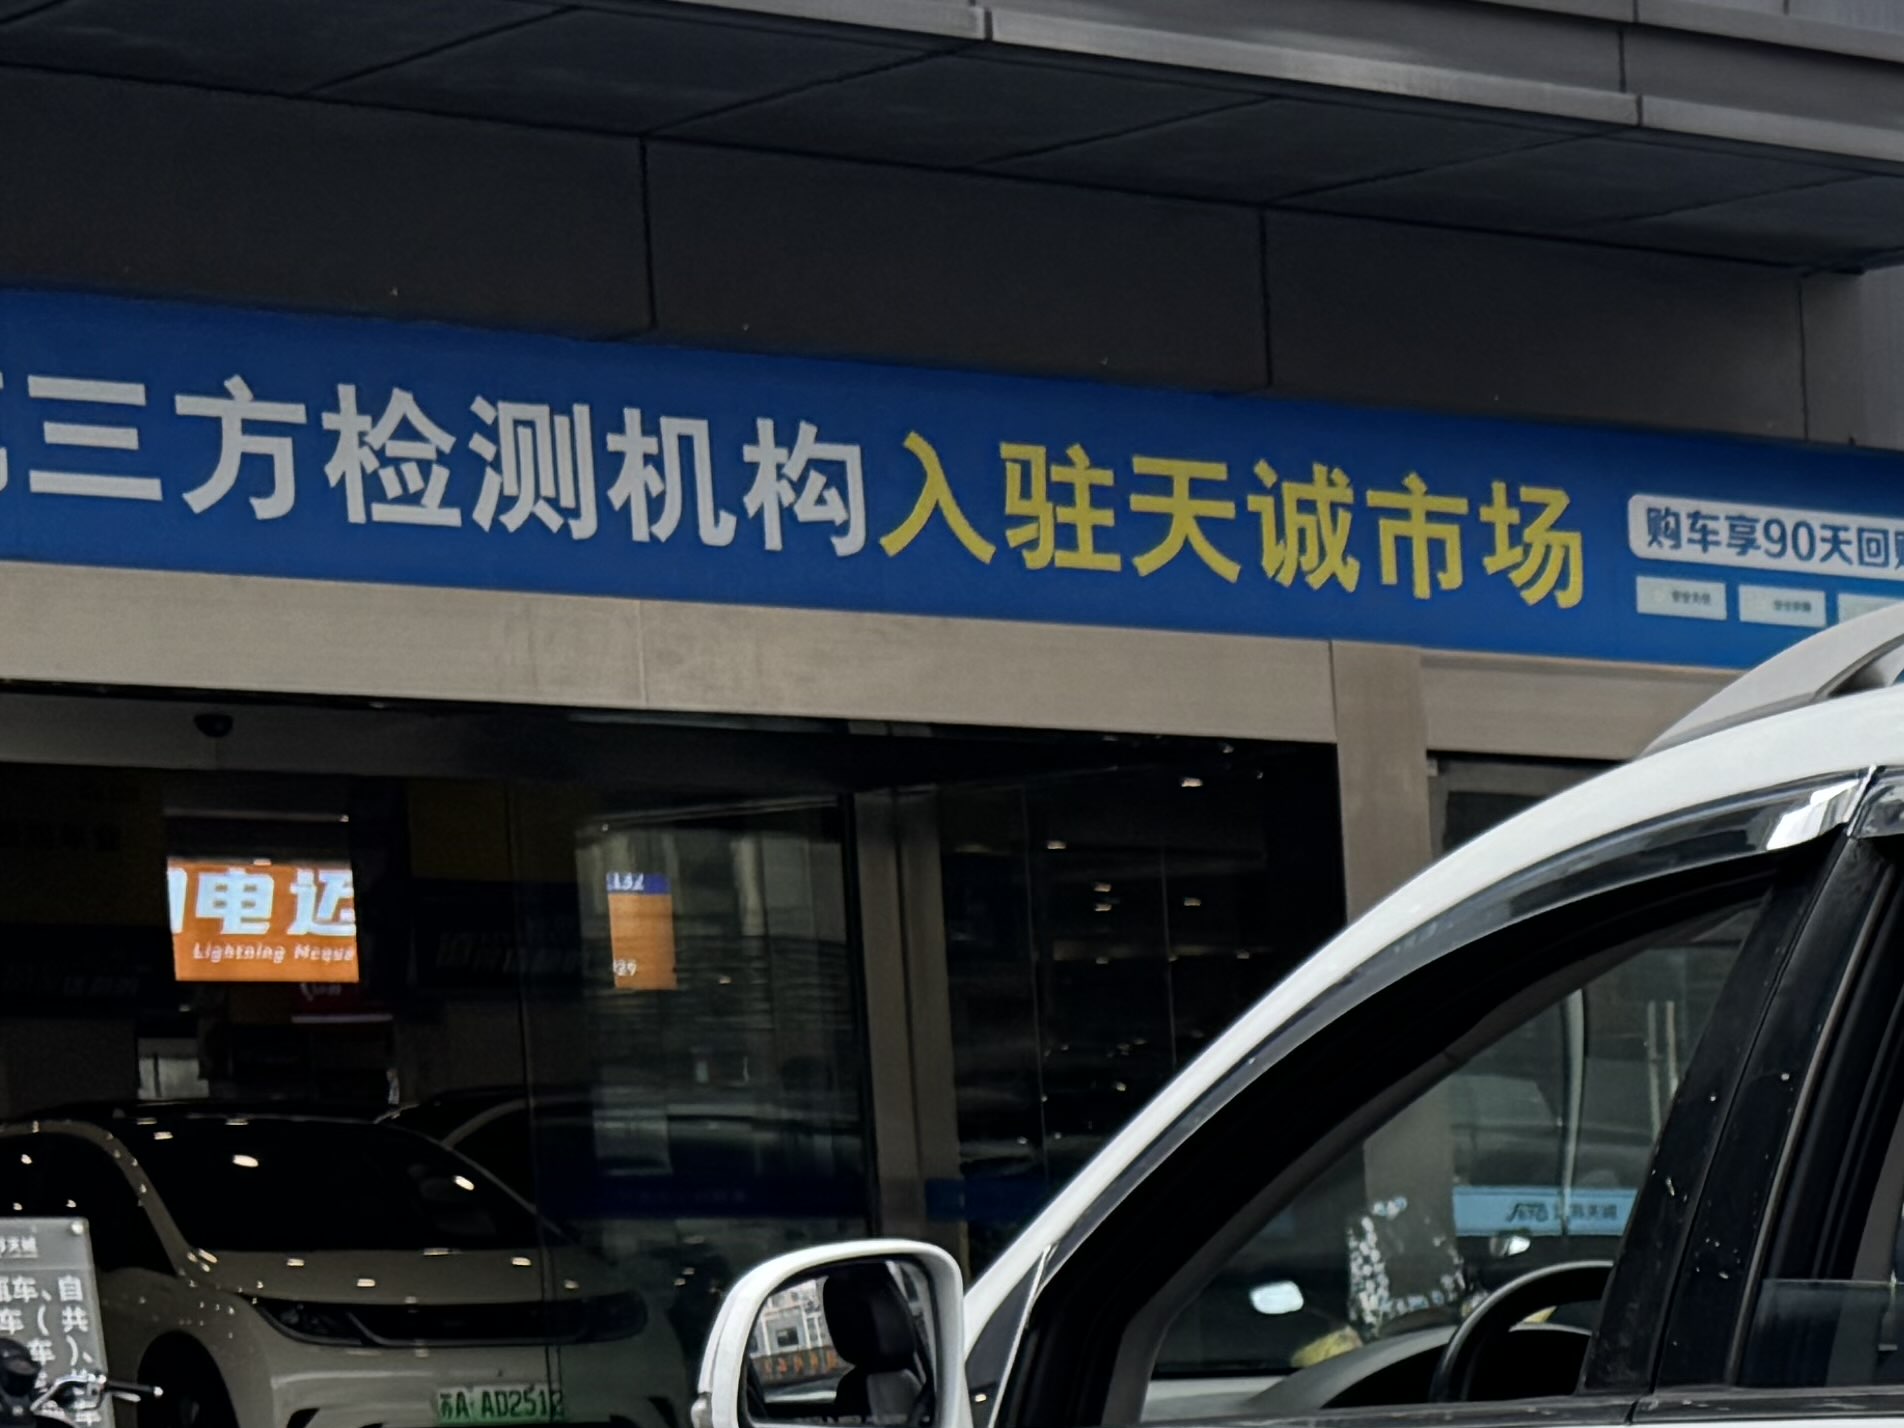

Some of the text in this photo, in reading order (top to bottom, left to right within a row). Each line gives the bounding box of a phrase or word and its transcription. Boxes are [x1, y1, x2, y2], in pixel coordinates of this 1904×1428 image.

[0, 371, 1584, 609] 三方检测机构入驻天诚市场
[193, 942, 286, 964] Lightning
